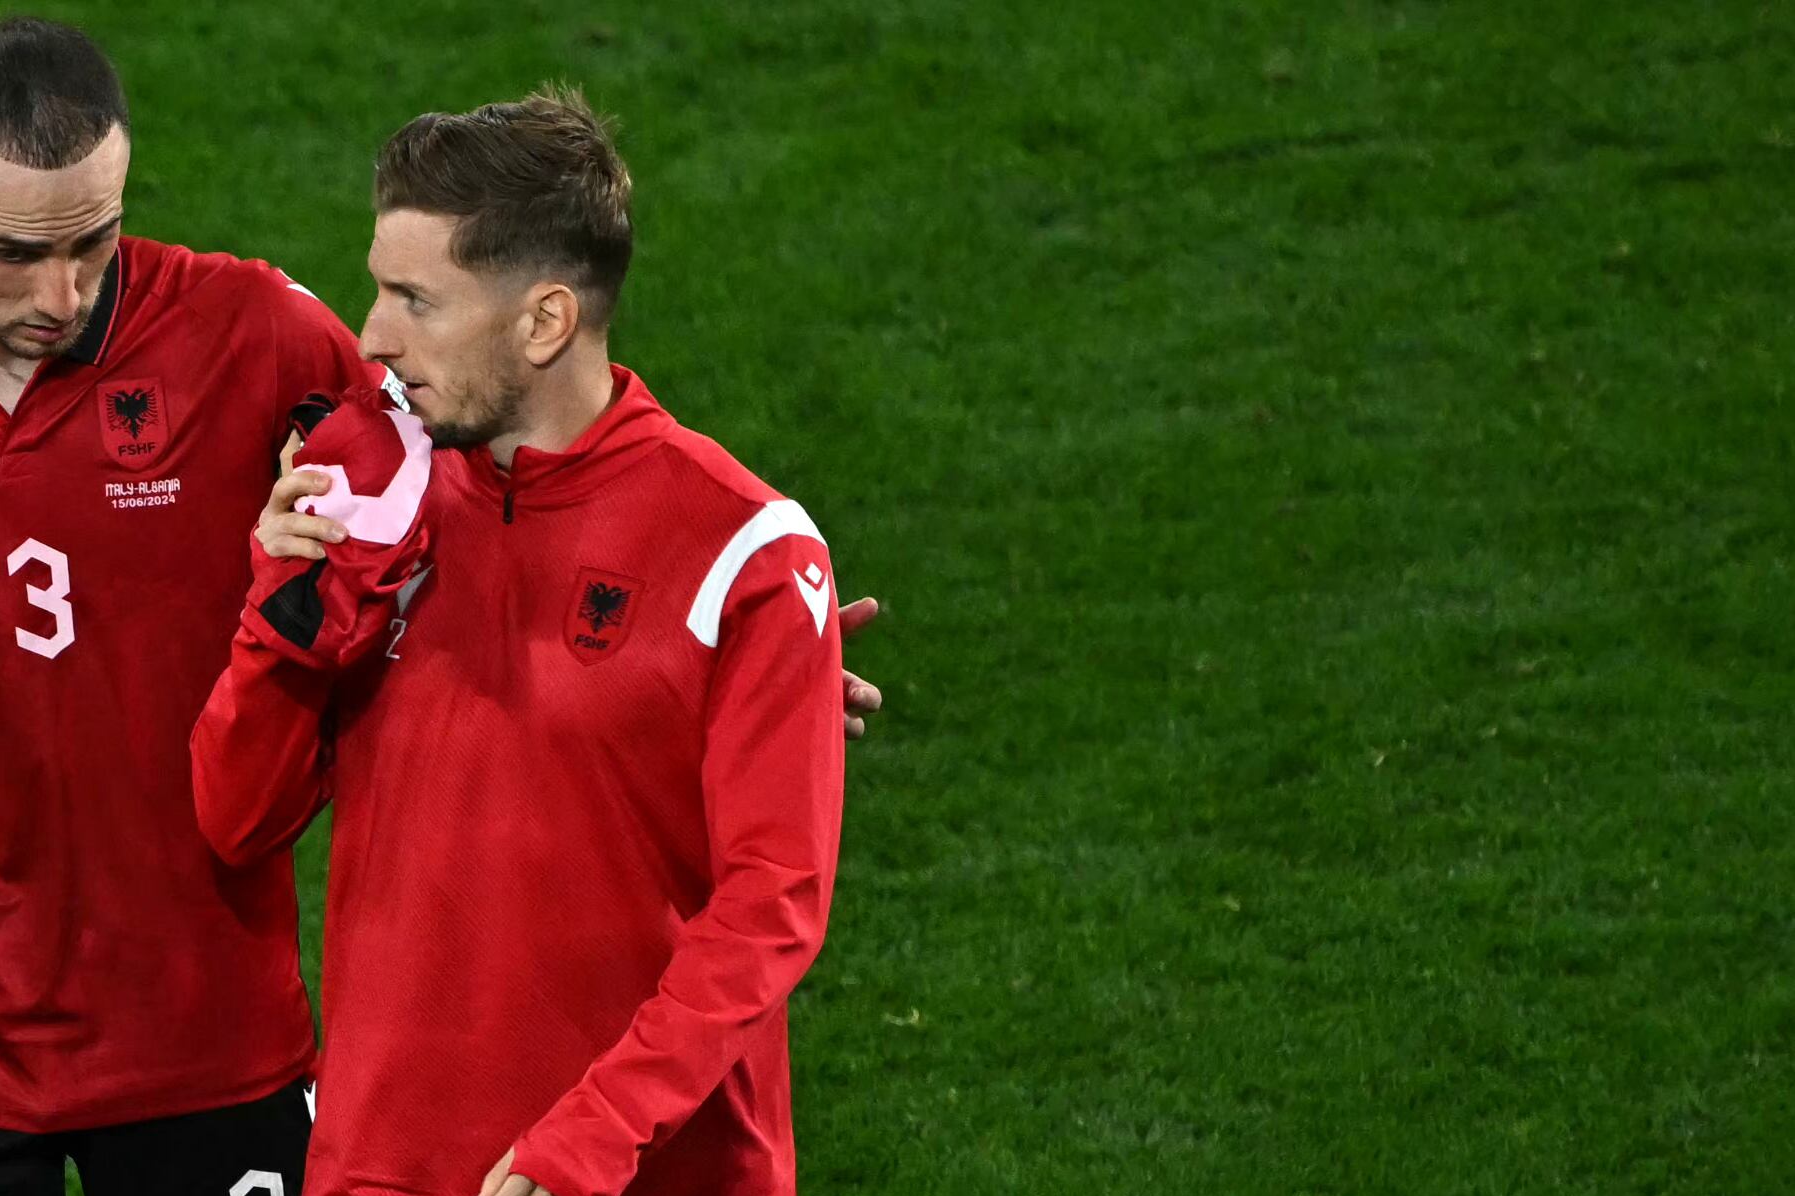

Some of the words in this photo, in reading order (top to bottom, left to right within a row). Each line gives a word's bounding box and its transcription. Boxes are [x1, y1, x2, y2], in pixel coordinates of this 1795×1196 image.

[117, 442, 156, 456] FSHF
[105, 478, 181, 497] ITALY-ALBANIA
[111, 494, 176, 509] 15/06/2024
[6, 537, 76, 660] 3
[386, 618, 407, 660] 2
